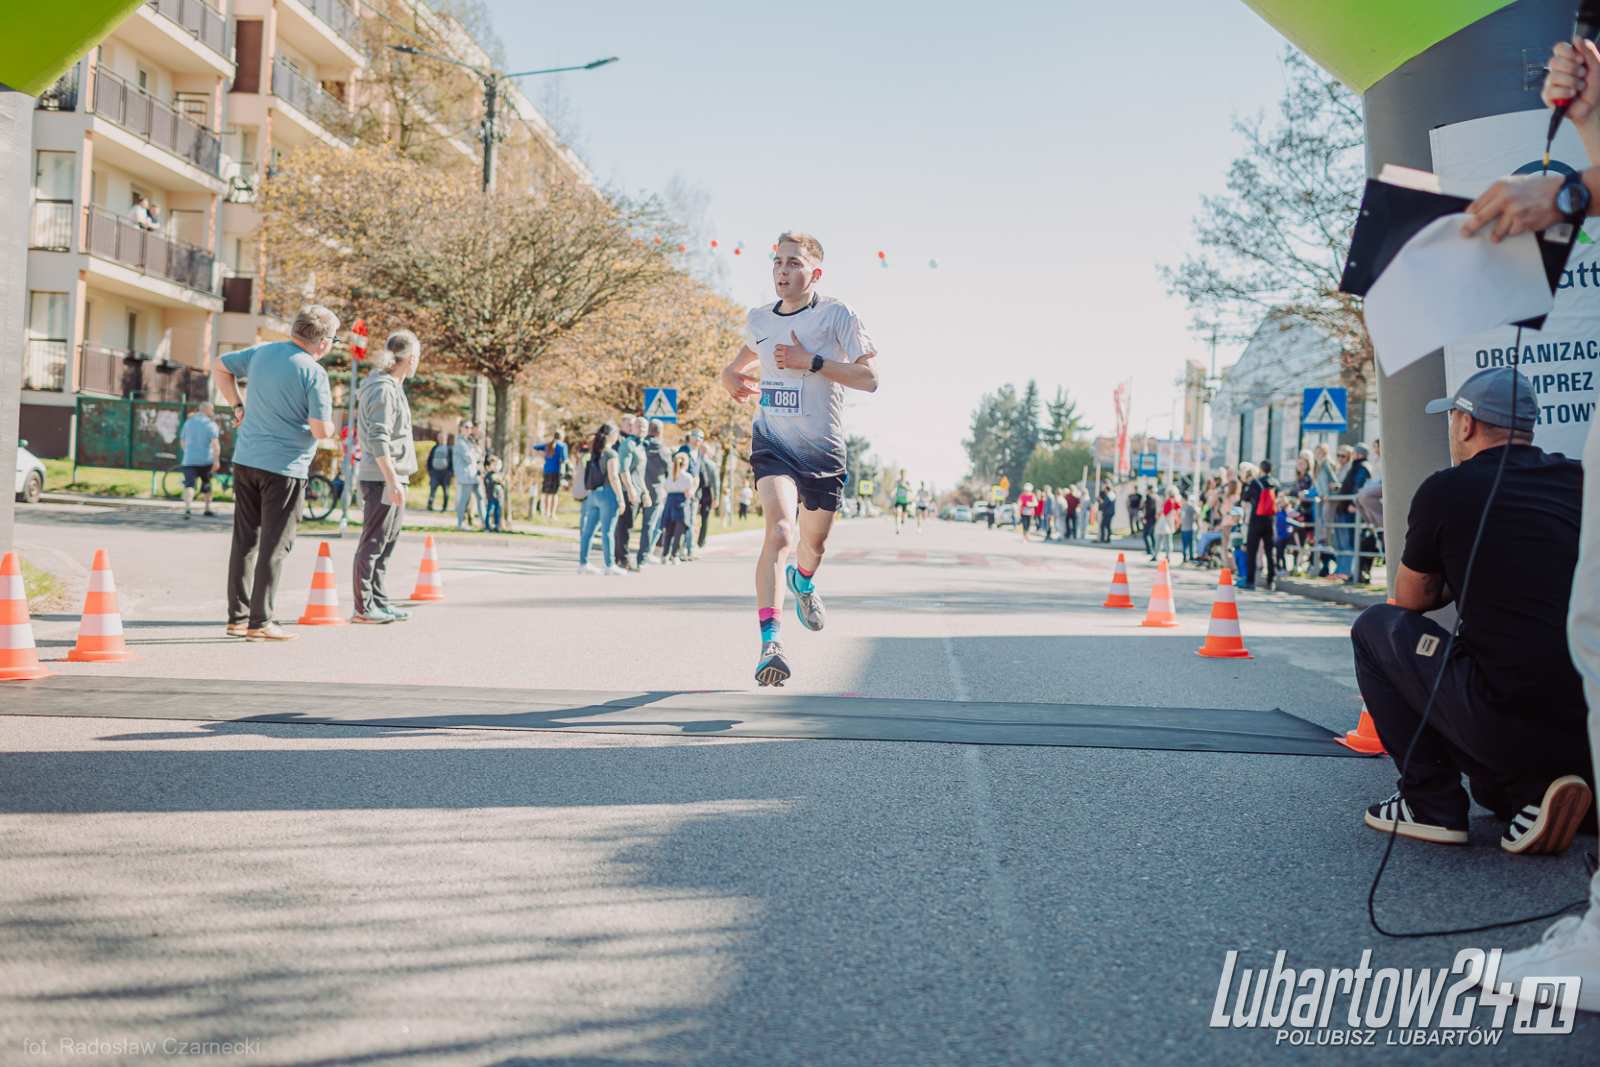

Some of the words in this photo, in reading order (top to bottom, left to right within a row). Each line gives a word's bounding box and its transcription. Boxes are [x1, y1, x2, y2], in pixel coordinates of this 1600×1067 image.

[1475, 340, 1600, 369] ORGANIZAC
[774, 390, 797, 407] 080
[1536, 402, 1595, 426] TOW
